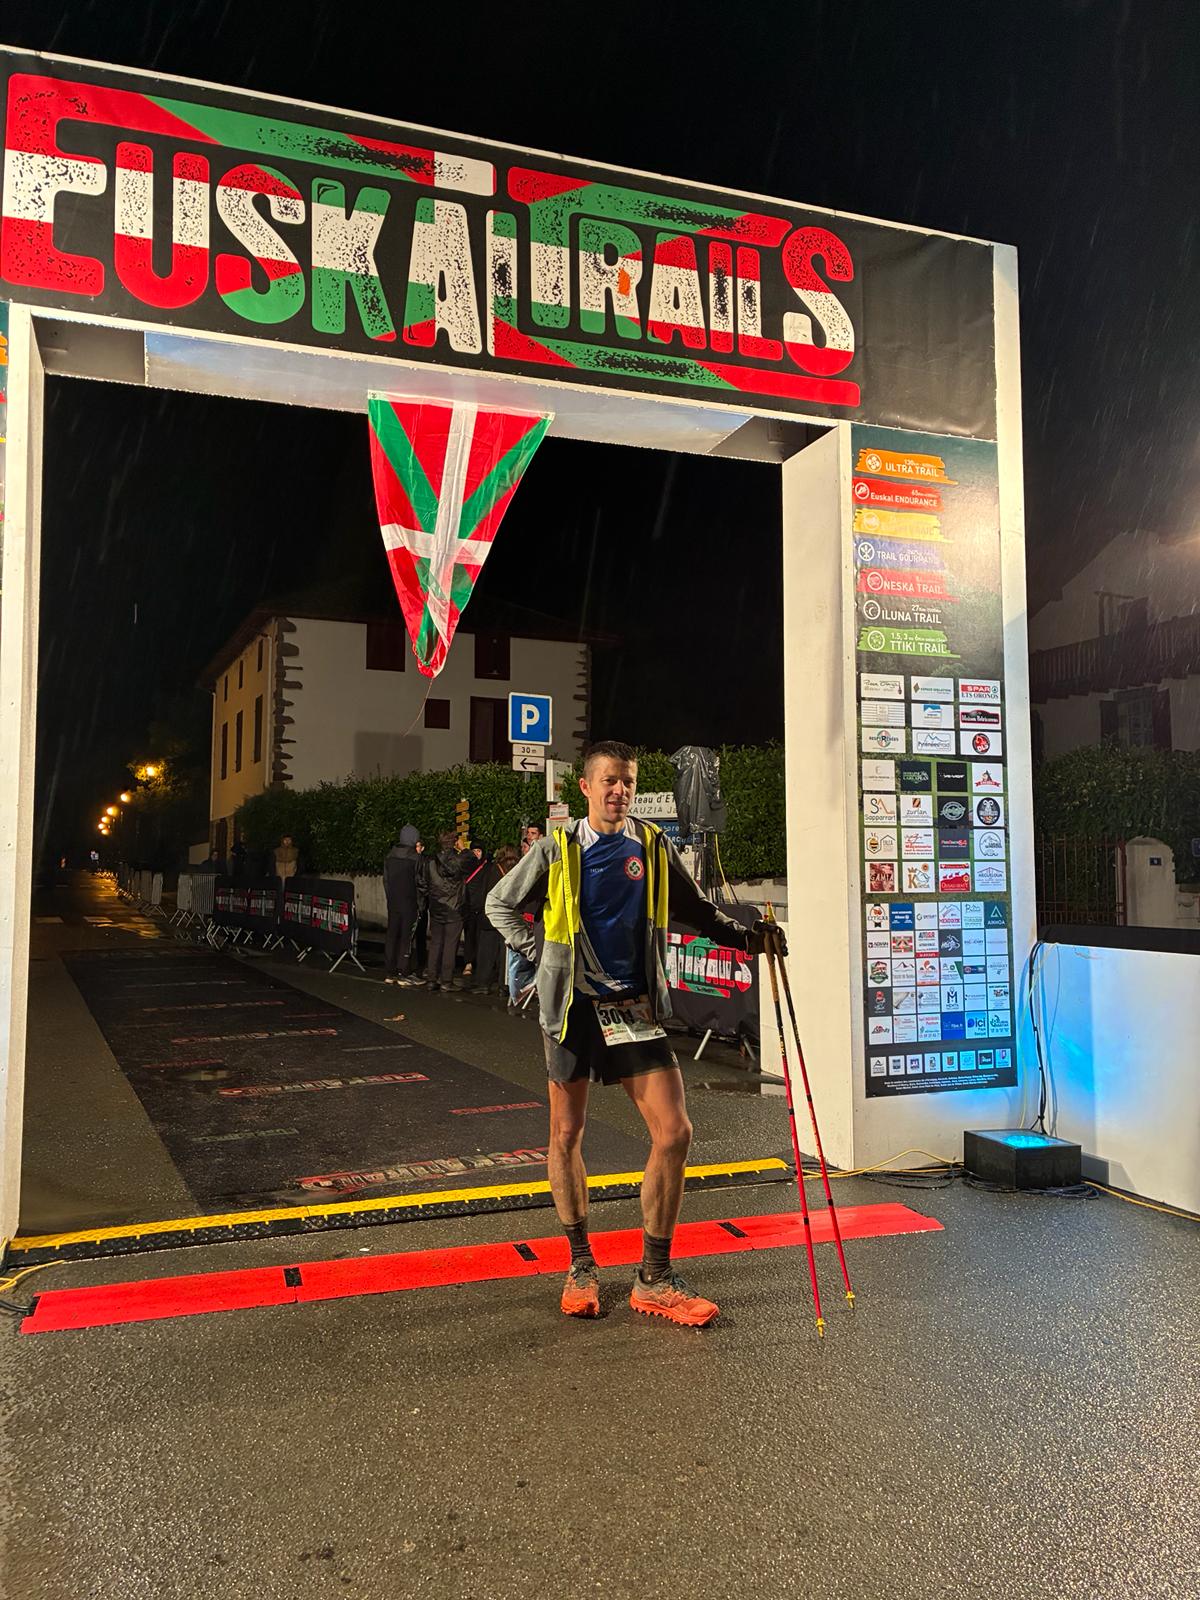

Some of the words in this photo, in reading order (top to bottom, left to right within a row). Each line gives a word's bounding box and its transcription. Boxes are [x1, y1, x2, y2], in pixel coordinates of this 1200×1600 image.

[885, 462, 914, 474] ULTRA
[915, 466, 939, 477] TRAIL
[870, 492, 894, 501] Euskal
[895, 496, 938, 507] ENDURANCE
[876, 551, 897, 561] TRAIL
[883, 581, 915, 592] NESKA
[917, 583, 943, 594] TRAIL
[882, 609, 912, 622] ILUNA
[913, 612, 942, 624] TRAIL
[890, 640, 916, 651] TTIKI
[918, 643, 948, 654] TRAIL
[967, 685, 990, 693] SPAR
[521, 703, 540, 734] P
[521, 746, 531, 754] 30
[634, 796, 654, 804] teau
